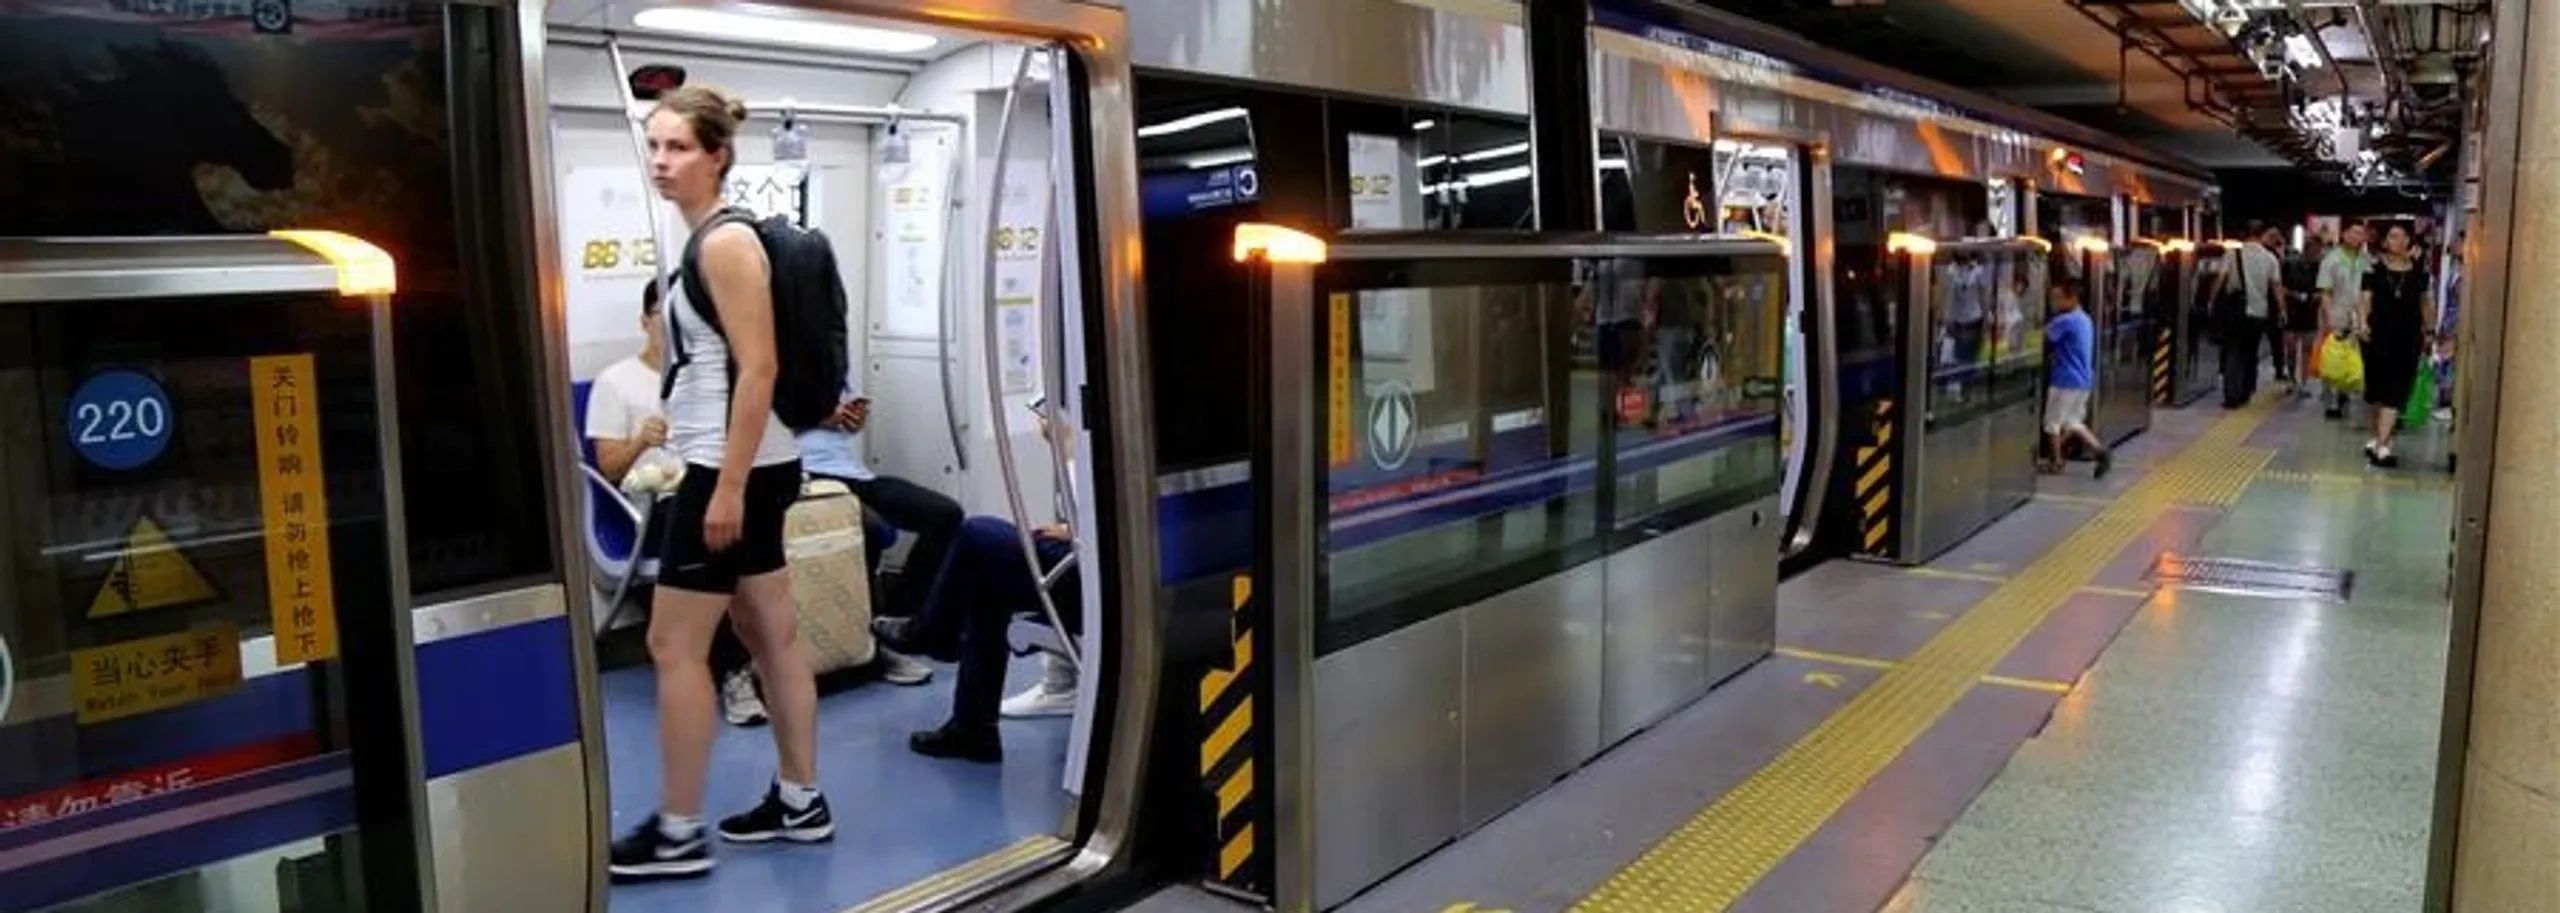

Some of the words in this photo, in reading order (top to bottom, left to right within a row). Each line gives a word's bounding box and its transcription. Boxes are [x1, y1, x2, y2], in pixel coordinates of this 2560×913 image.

[79, 397, 164, 443] 220
[91, 634, 221, 687] 当心夹手
